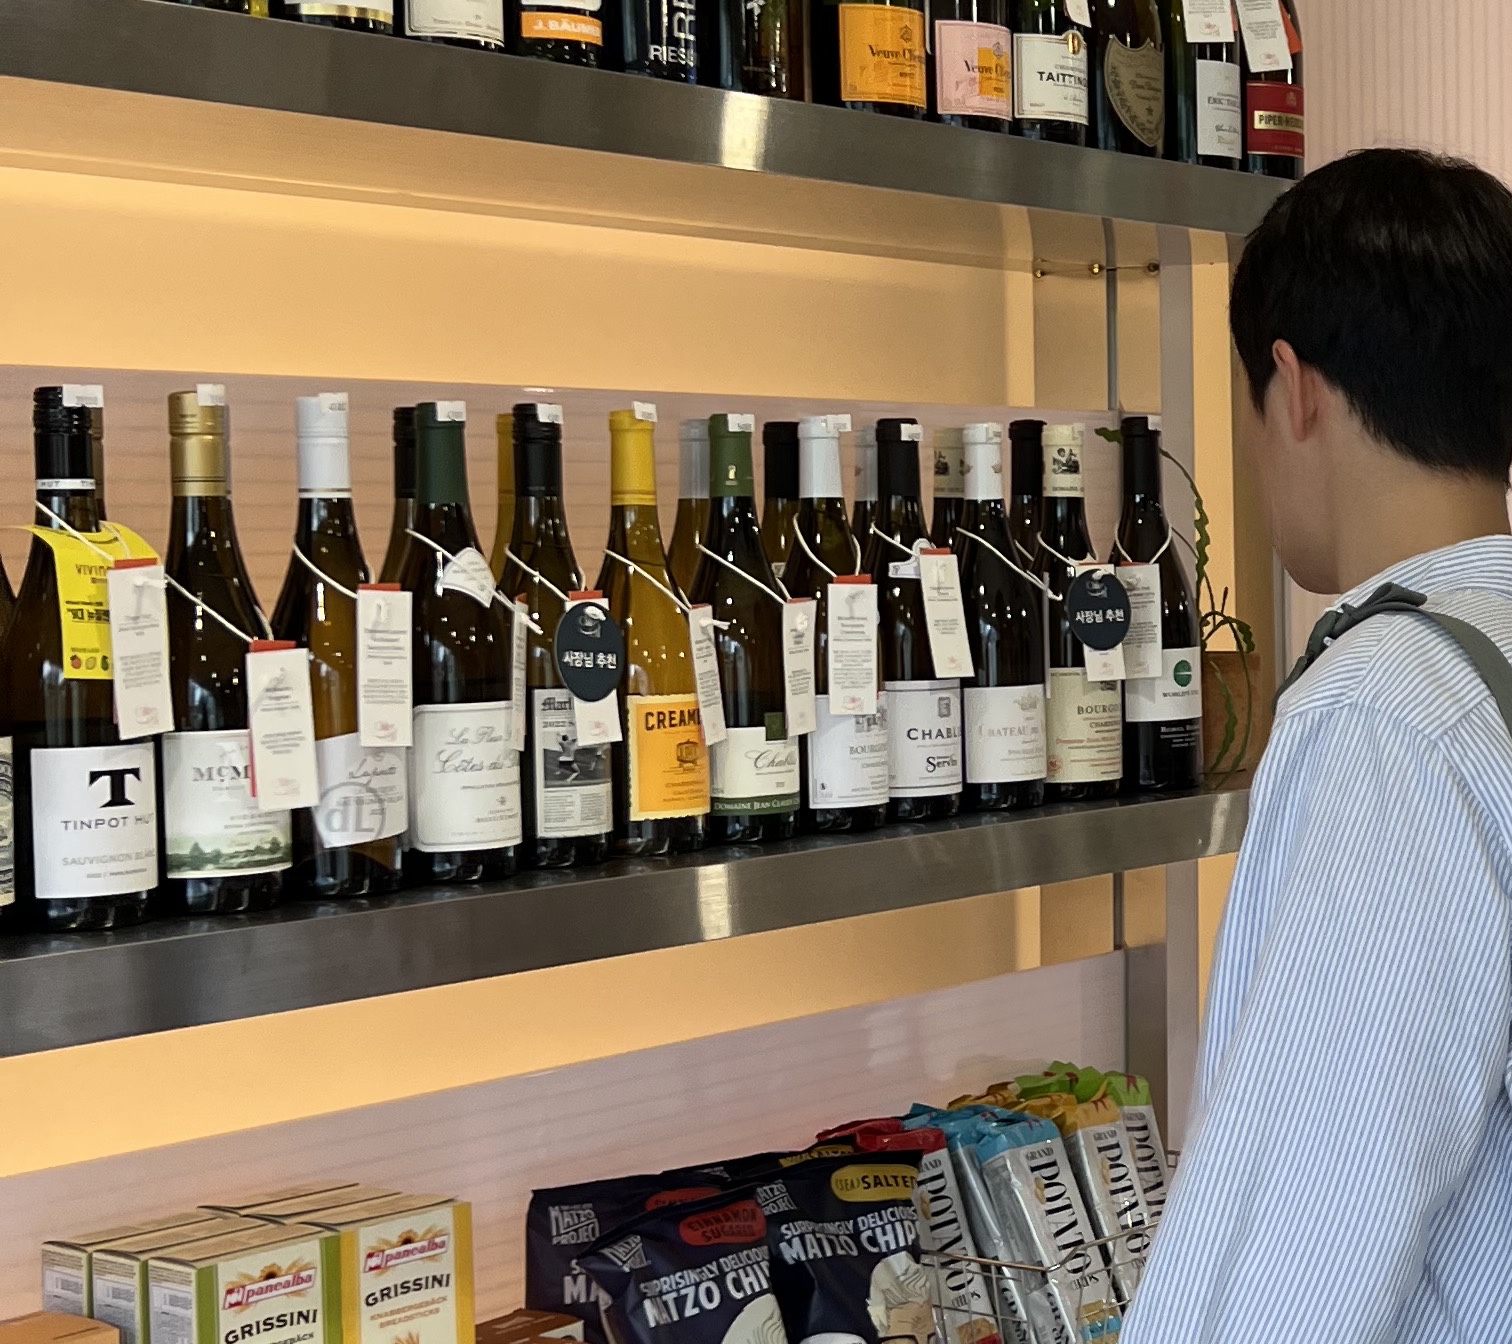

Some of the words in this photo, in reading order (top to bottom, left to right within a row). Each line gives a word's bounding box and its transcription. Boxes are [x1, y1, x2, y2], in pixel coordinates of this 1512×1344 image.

[1075, 609, 1104, 624] 사장님
[1106, 608, 1125, 623] 추천
[563, 650, 594, 670] 사장님
[596, 651, 617, 670] 추천
[88, 767, 142, 809] T
[60, 817, 129, 831] TINPOT
[1093, 1129, 1119, 1142] GRAND
[1025, 1146, 1055, 1163] GRAND
[1097, 1142, 1152, 1254] POTATO
[549, 1207, 596, 1236] MATZO
[916, 1169, 976, 1293] POTATO
[1030, 1159, 1093, 1275] POTATO
[385, 1239, 447, 1264] panealba
[779, 1232, 859, 1266] MATZO
[245, 1271, 313, 1302] panealba
[364, 1273, 451, 1308] GRISSINI
